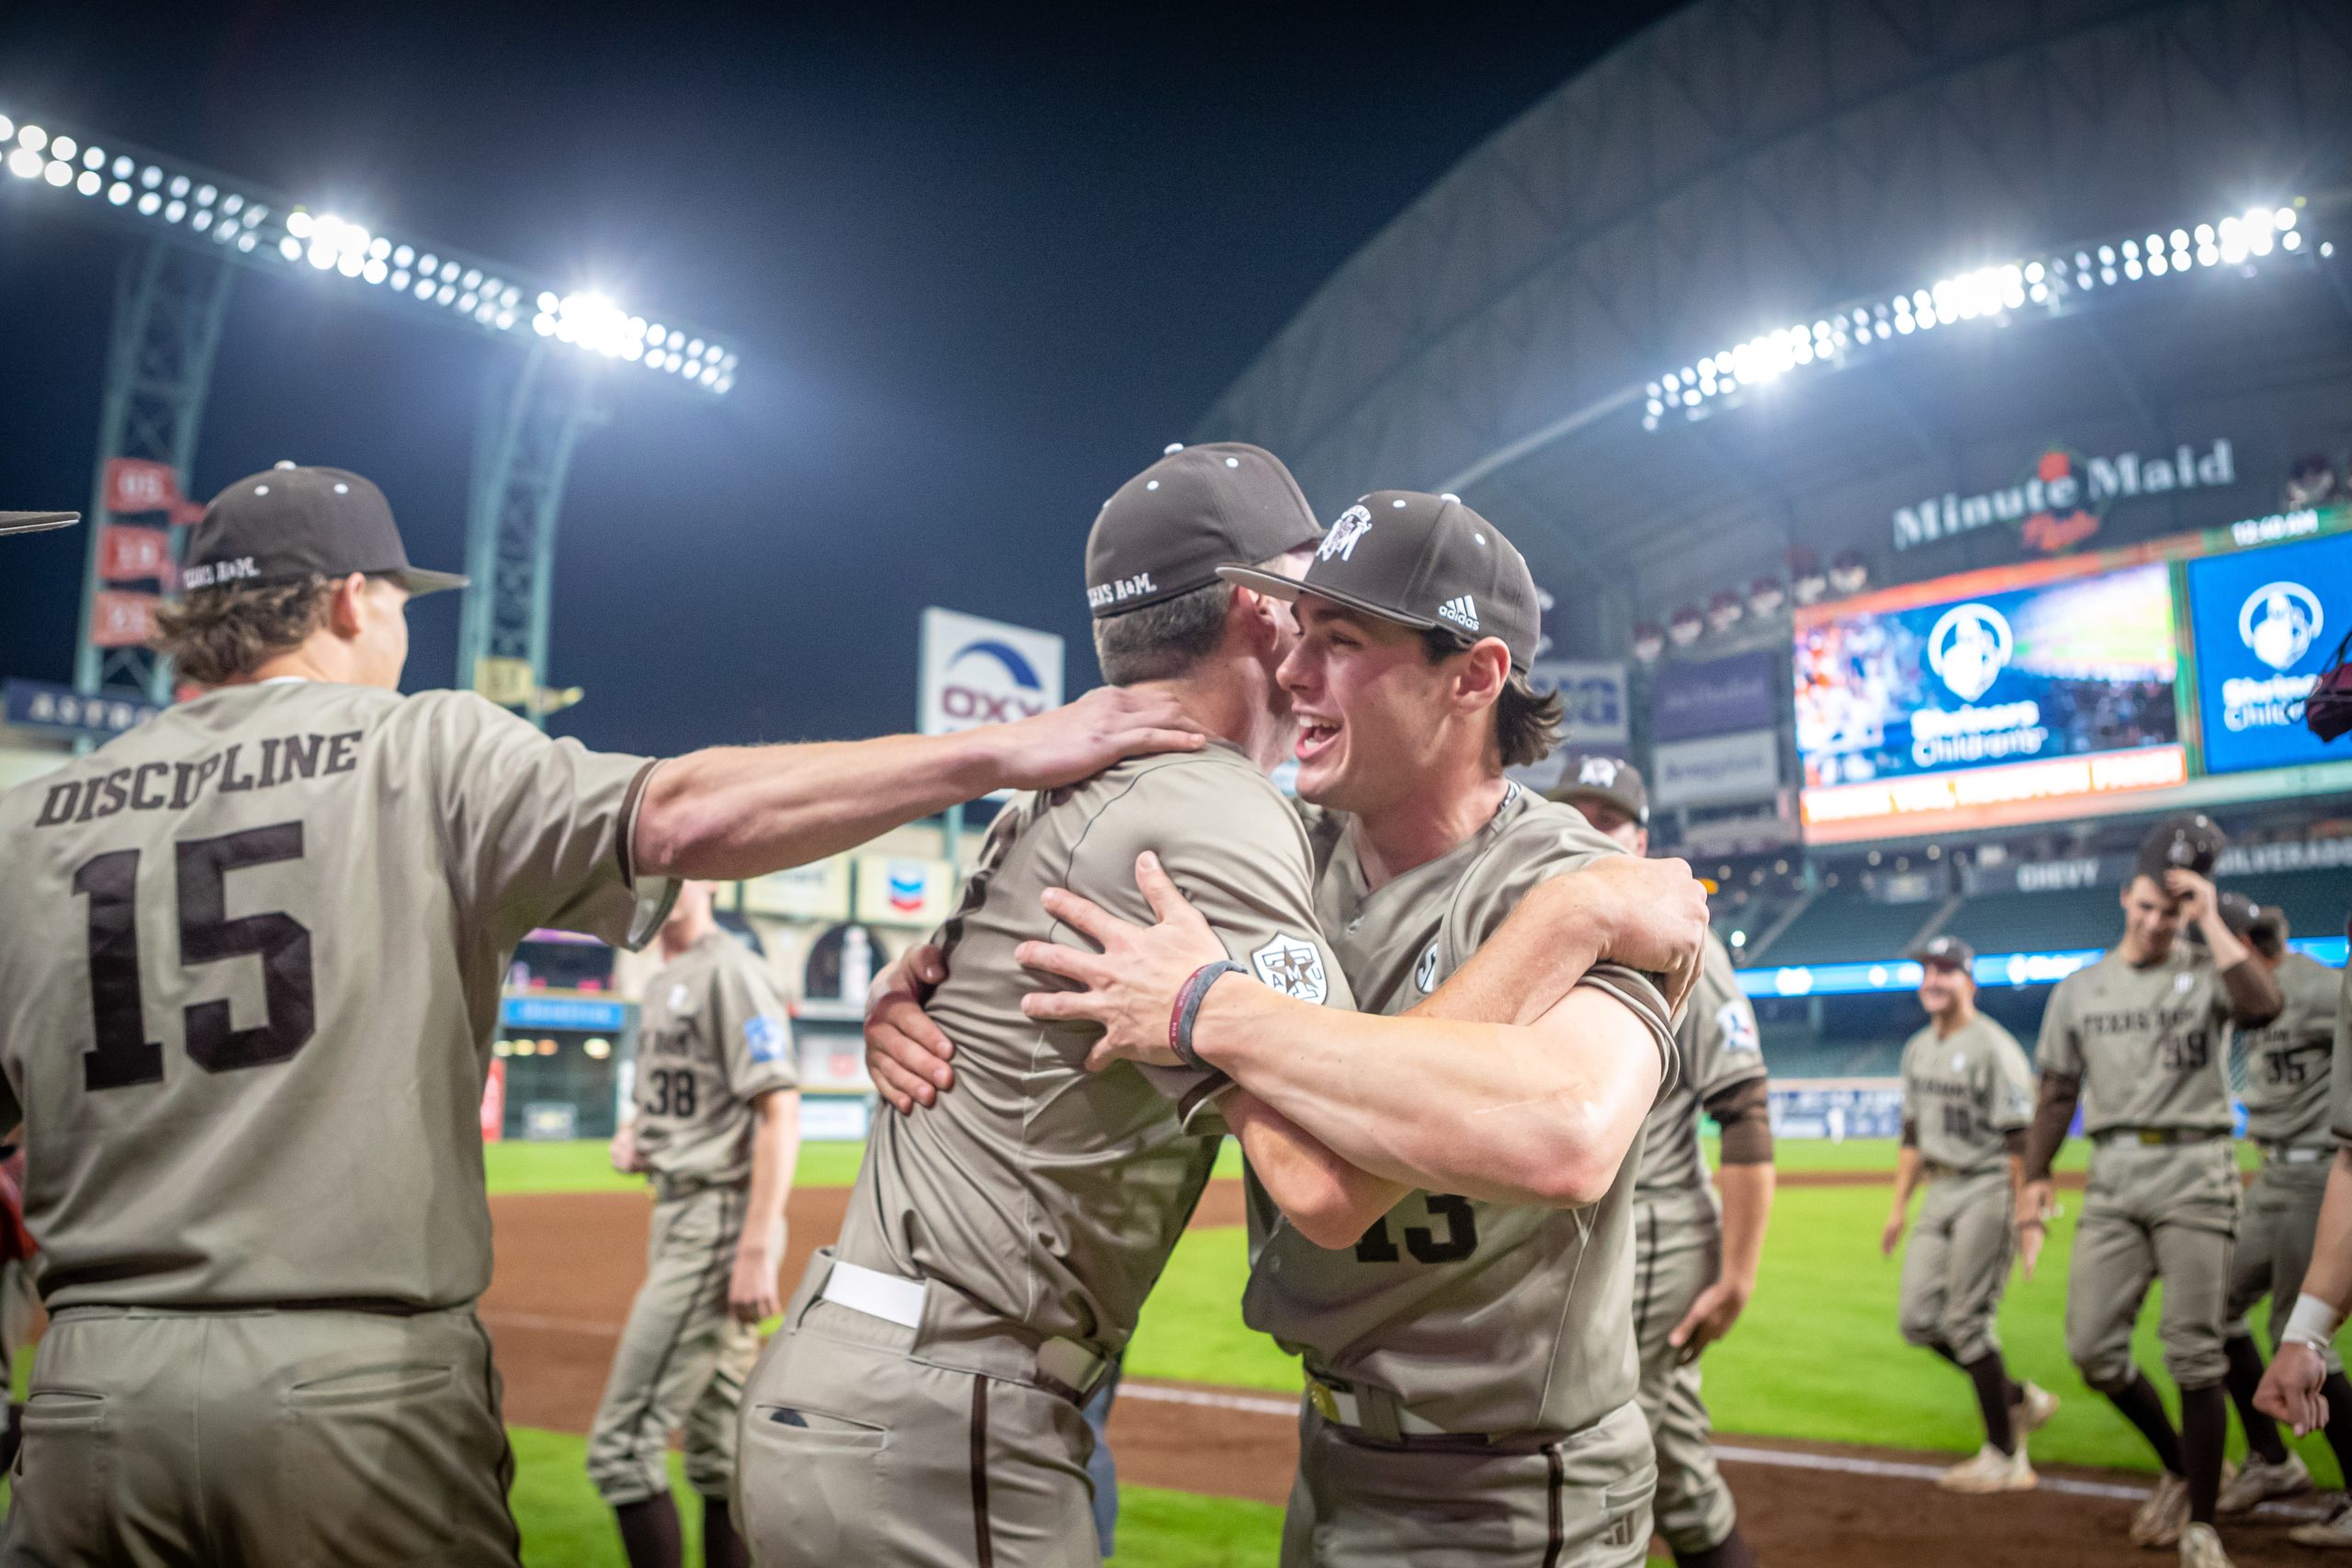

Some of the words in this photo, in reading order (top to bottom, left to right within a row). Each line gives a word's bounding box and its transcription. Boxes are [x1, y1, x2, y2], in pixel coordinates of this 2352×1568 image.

[1893, 474, 2079, 551] Minute
[2087, 437, 2235, 502] Maid
[1439, 604, 1480, 631] adidas
[35, 729, 364, 828] DISCIPLINE
[72, 819, 317, 1092] 15
[646, 1068, 696, 1119] 38
